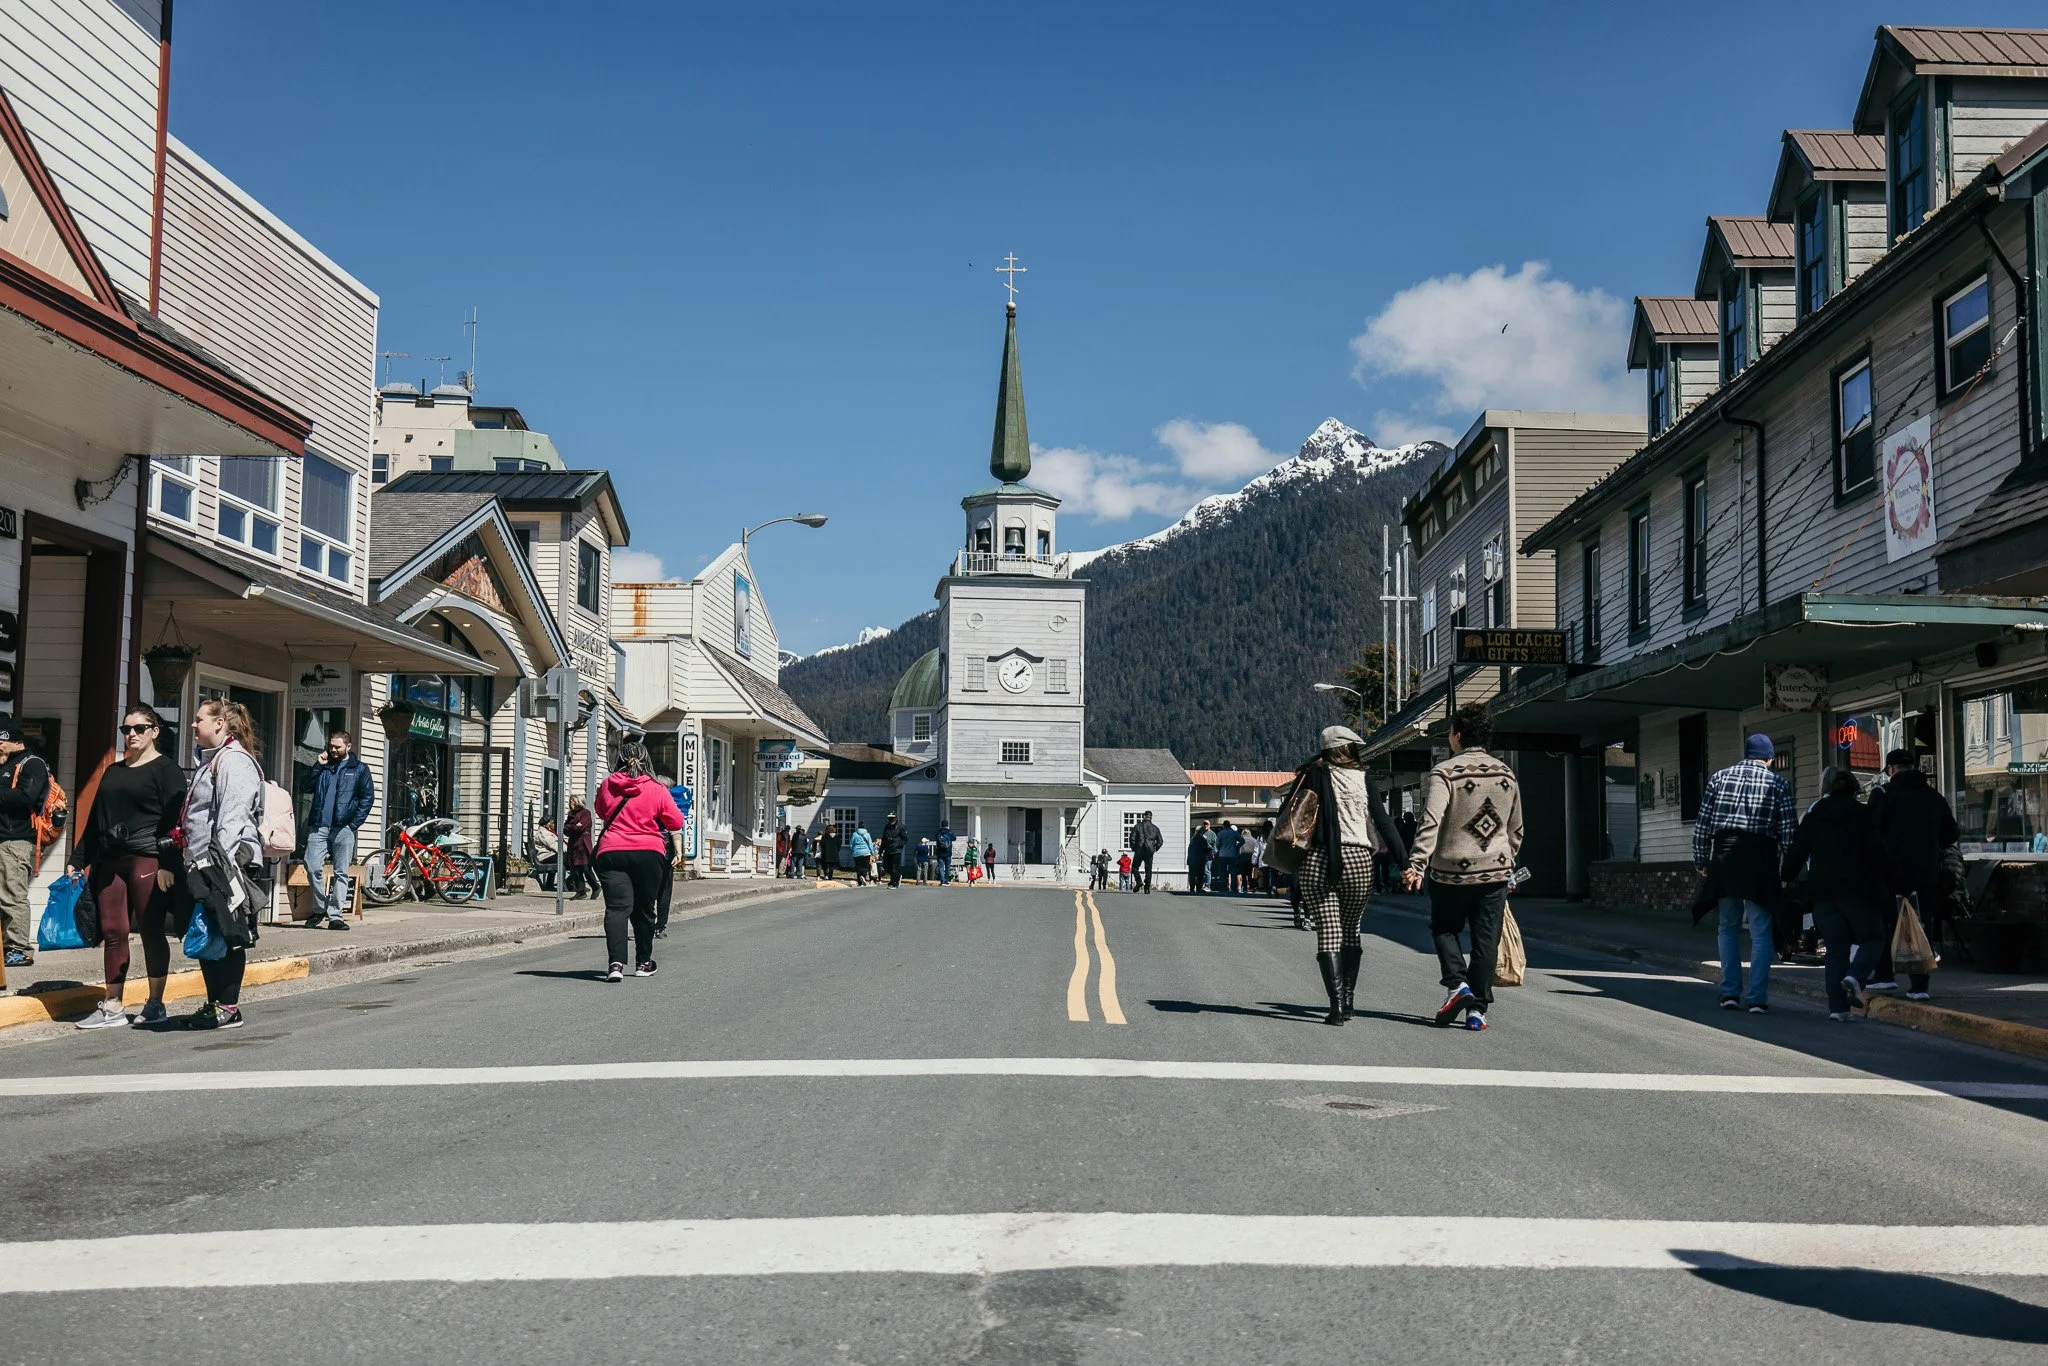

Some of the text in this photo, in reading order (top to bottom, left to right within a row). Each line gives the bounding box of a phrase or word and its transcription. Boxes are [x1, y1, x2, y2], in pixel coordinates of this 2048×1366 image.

[1486, 632, 1562, 647] LOG CACHE
[1487, 647, 1529, 661] GIFTS
[1838, 725, 1857, 744] OPEN
[778, 753, 800, 762] Eyed
[764, 761, 792, 769] BEAR
